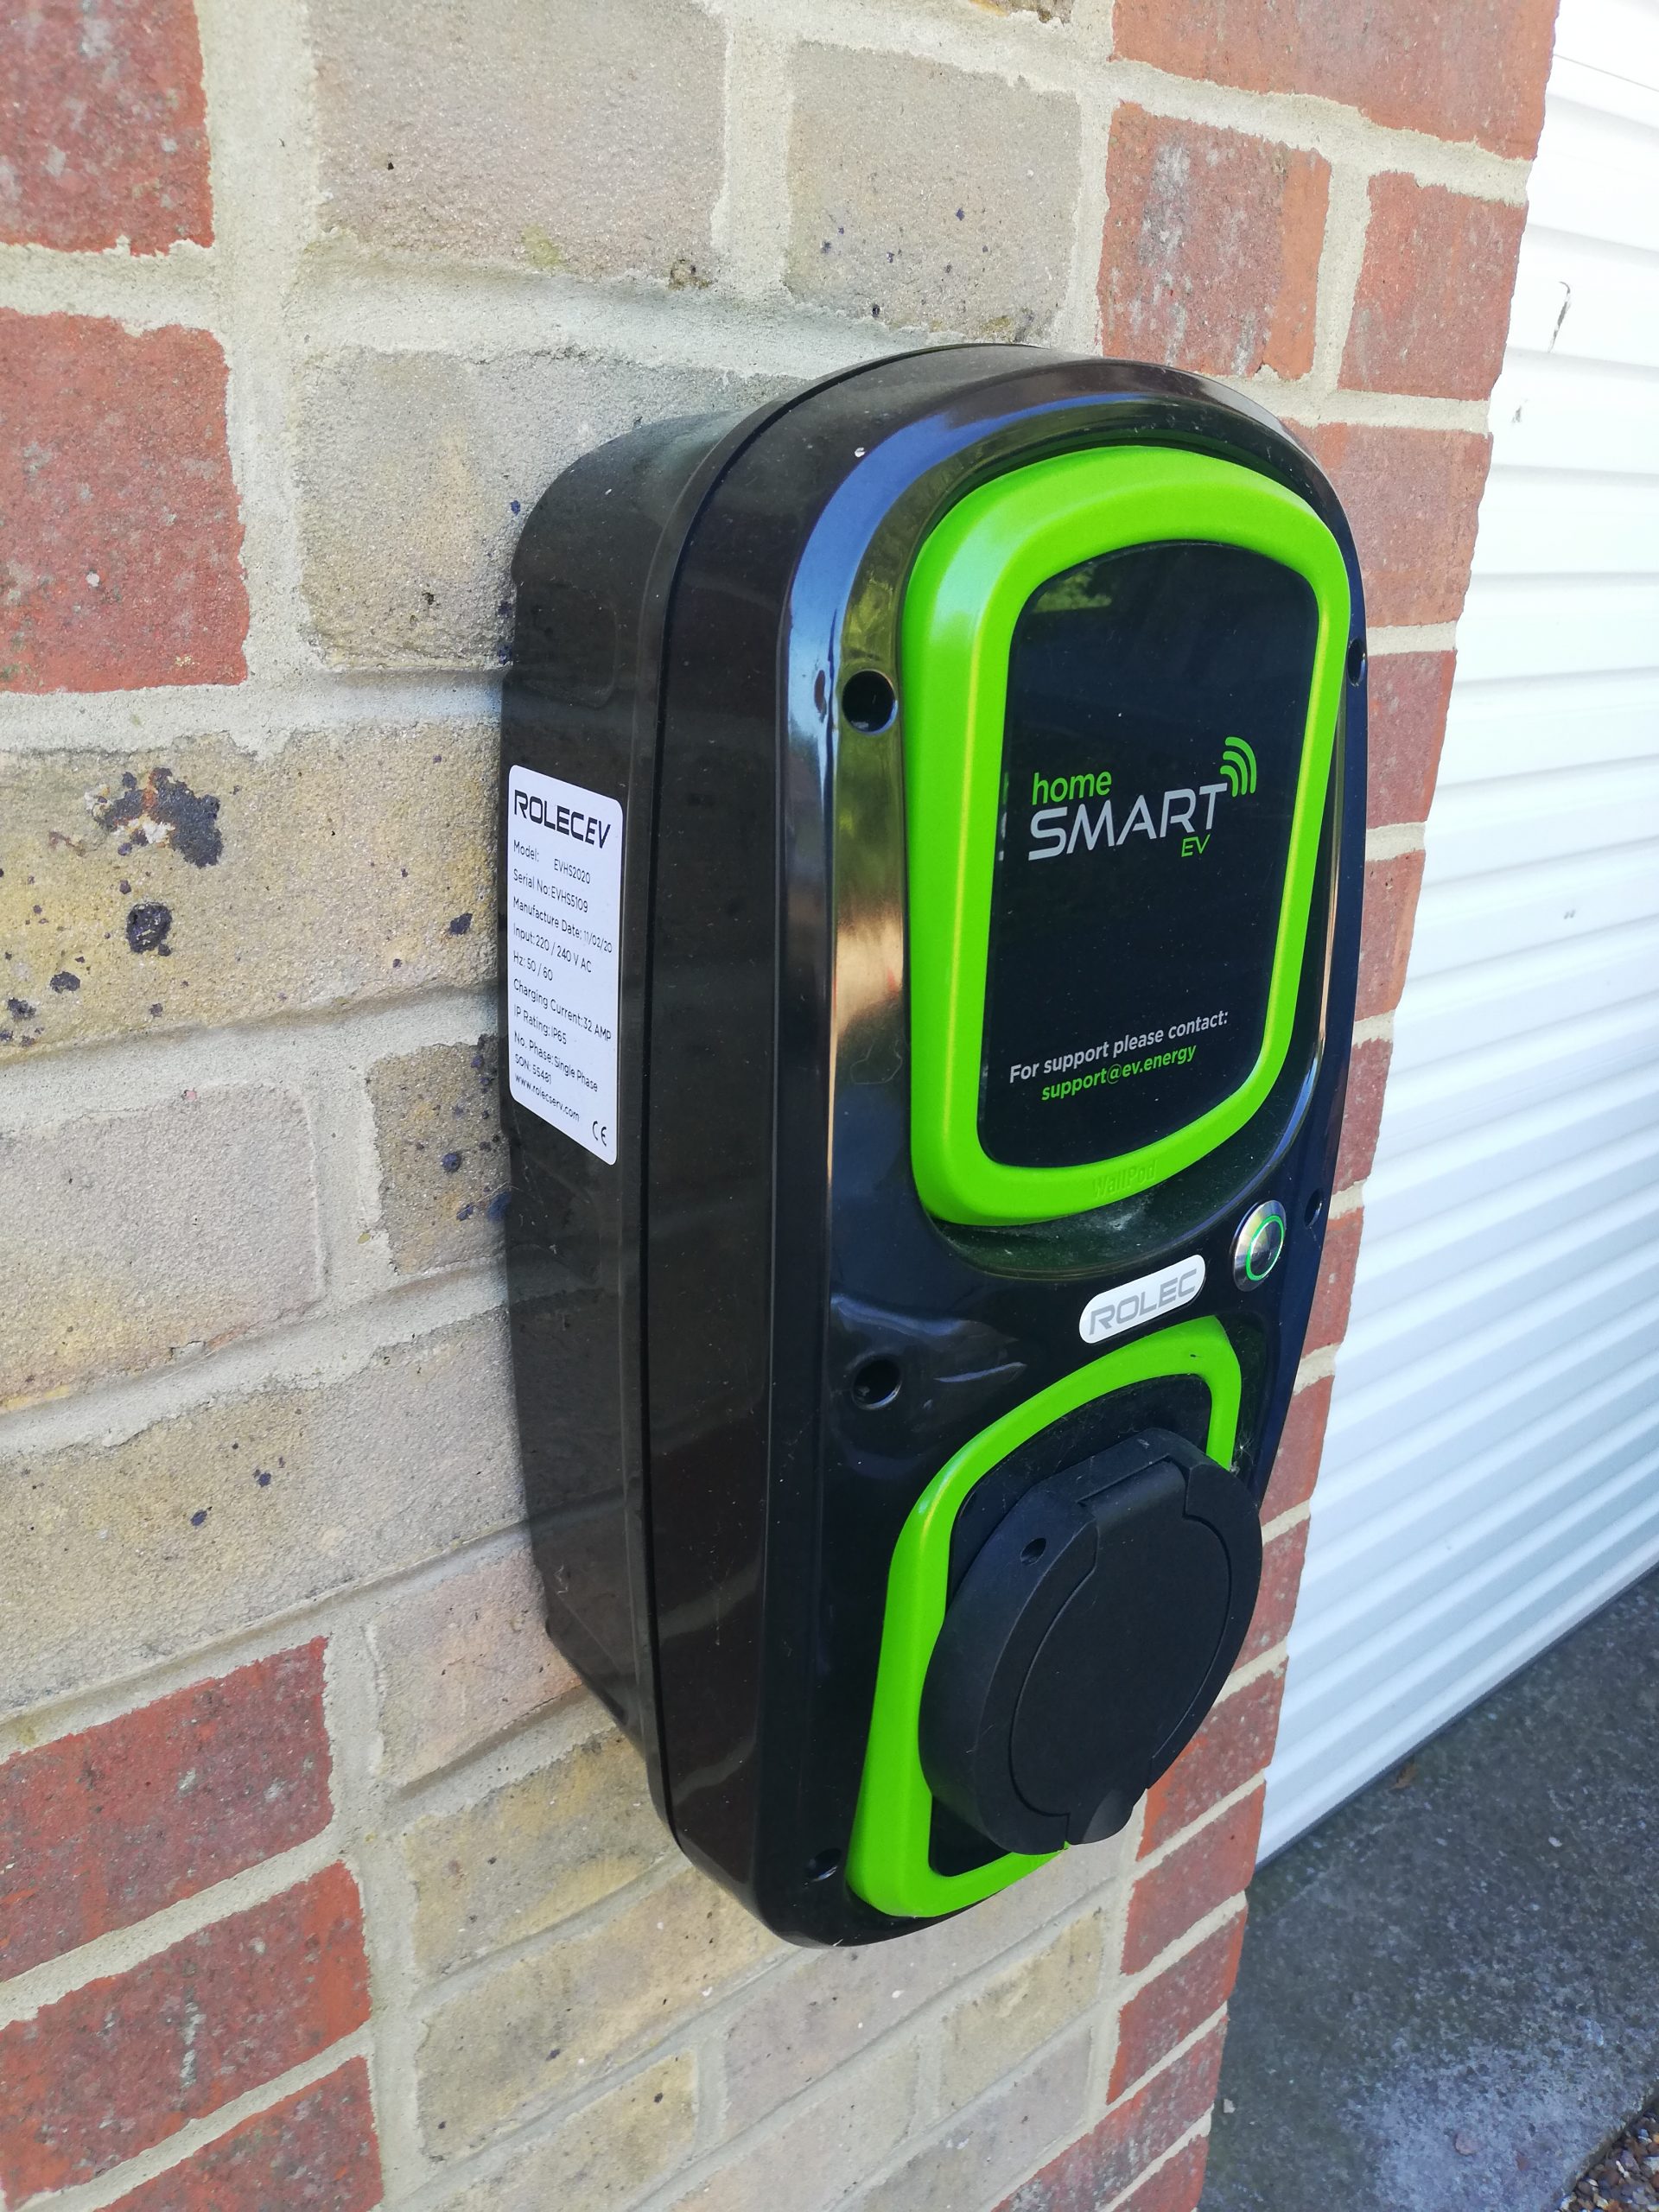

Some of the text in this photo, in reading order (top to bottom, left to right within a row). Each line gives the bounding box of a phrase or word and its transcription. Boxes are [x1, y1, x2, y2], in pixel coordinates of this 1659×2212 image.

[1031, 771, 1113, 805] home
[514, 789, 611, 849] ROLECEV
[1028, 782, 1228, 861] SMART
[513, 839, 590, 884] Model: EVHS2020
[1181, 834, 1211, 857] EV
[513, 868, 535, 888] Serial
[513, 896, 559, 928] Manufacture
[562, 919, 582, 940] Date:
[527, 957, 536, 972] 50
[543, 967, 553, 981] 60
[556, 945, 571, 963] 240
[574, 952, 579, 966] V
[581, 957, 592, 973] AC
[513, 978, 548, 1009] Charging
[594, 1024, 612, 1041] AMP
[514, 1004, 521, 1017] IP
[514, 1030, 527, 1049] No.
[577, 1069, 598, 1092] Phase
[1009, 1010, 1229, 1084] For support please contact:
[1041, 1044, 1197, 1101] support@ev.energy
[1089, 1268, 1197, 1335] ROLEC
